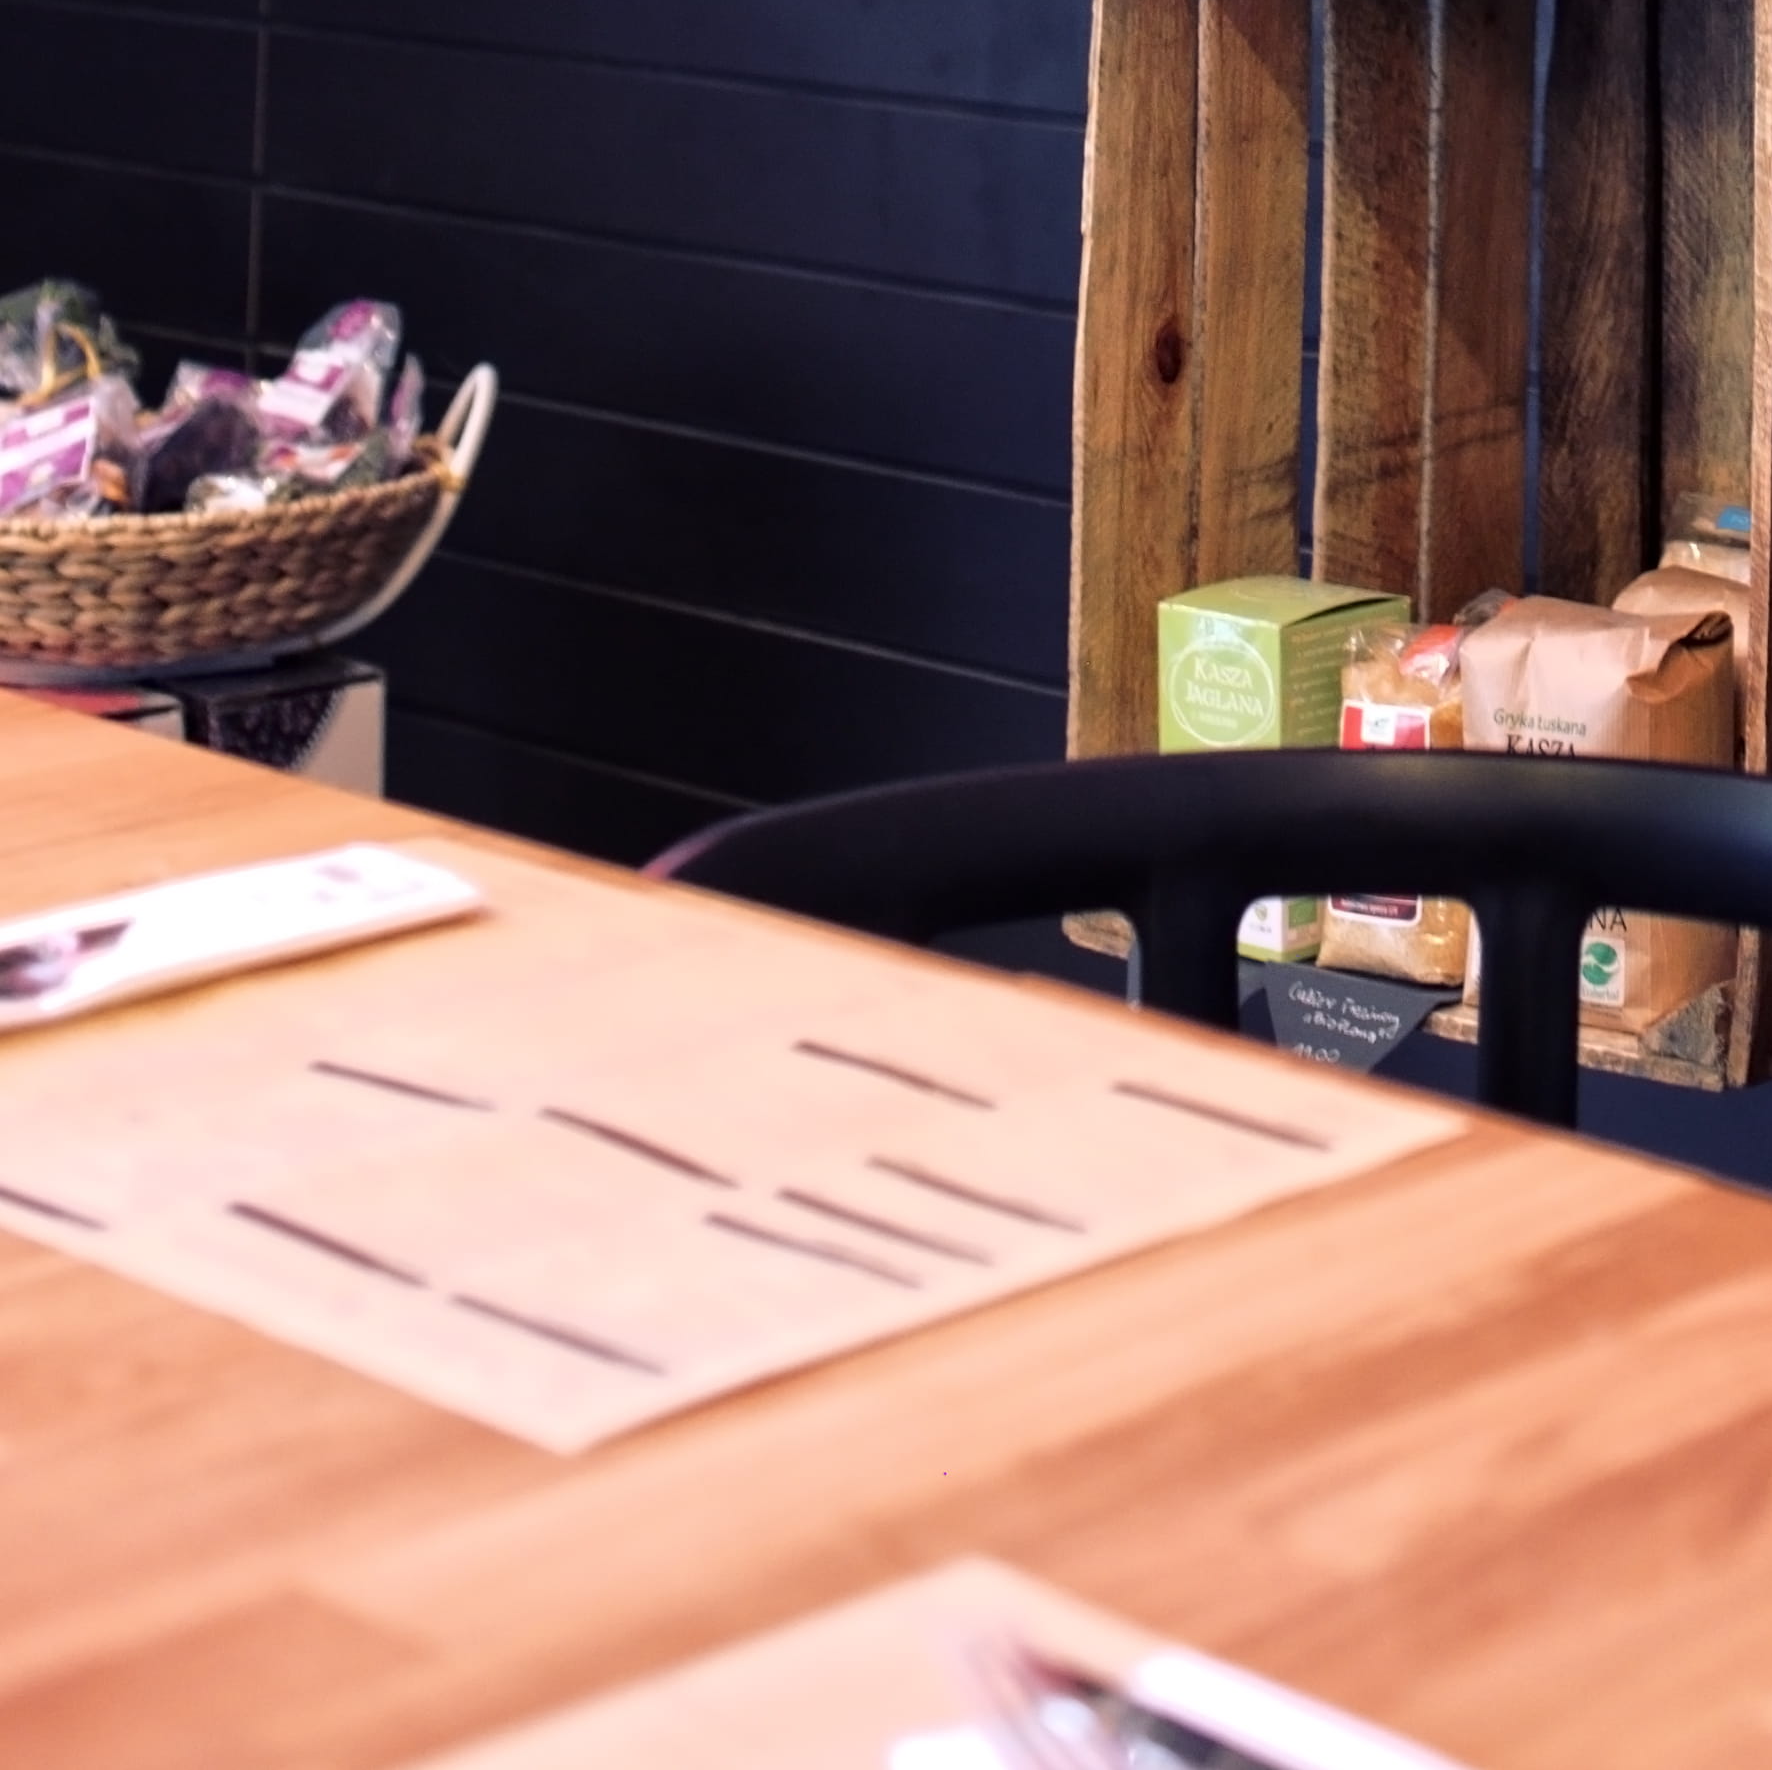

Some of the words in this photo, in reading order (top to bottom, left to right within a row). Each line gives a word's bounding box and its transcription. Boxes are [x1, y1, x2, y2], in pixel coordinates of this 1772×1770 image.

[1194, 656, 1253, 688] KASZA
[1186, 680, 1264, 717] JAGLANA
[1493, 707, 1535, 730] Gryka
